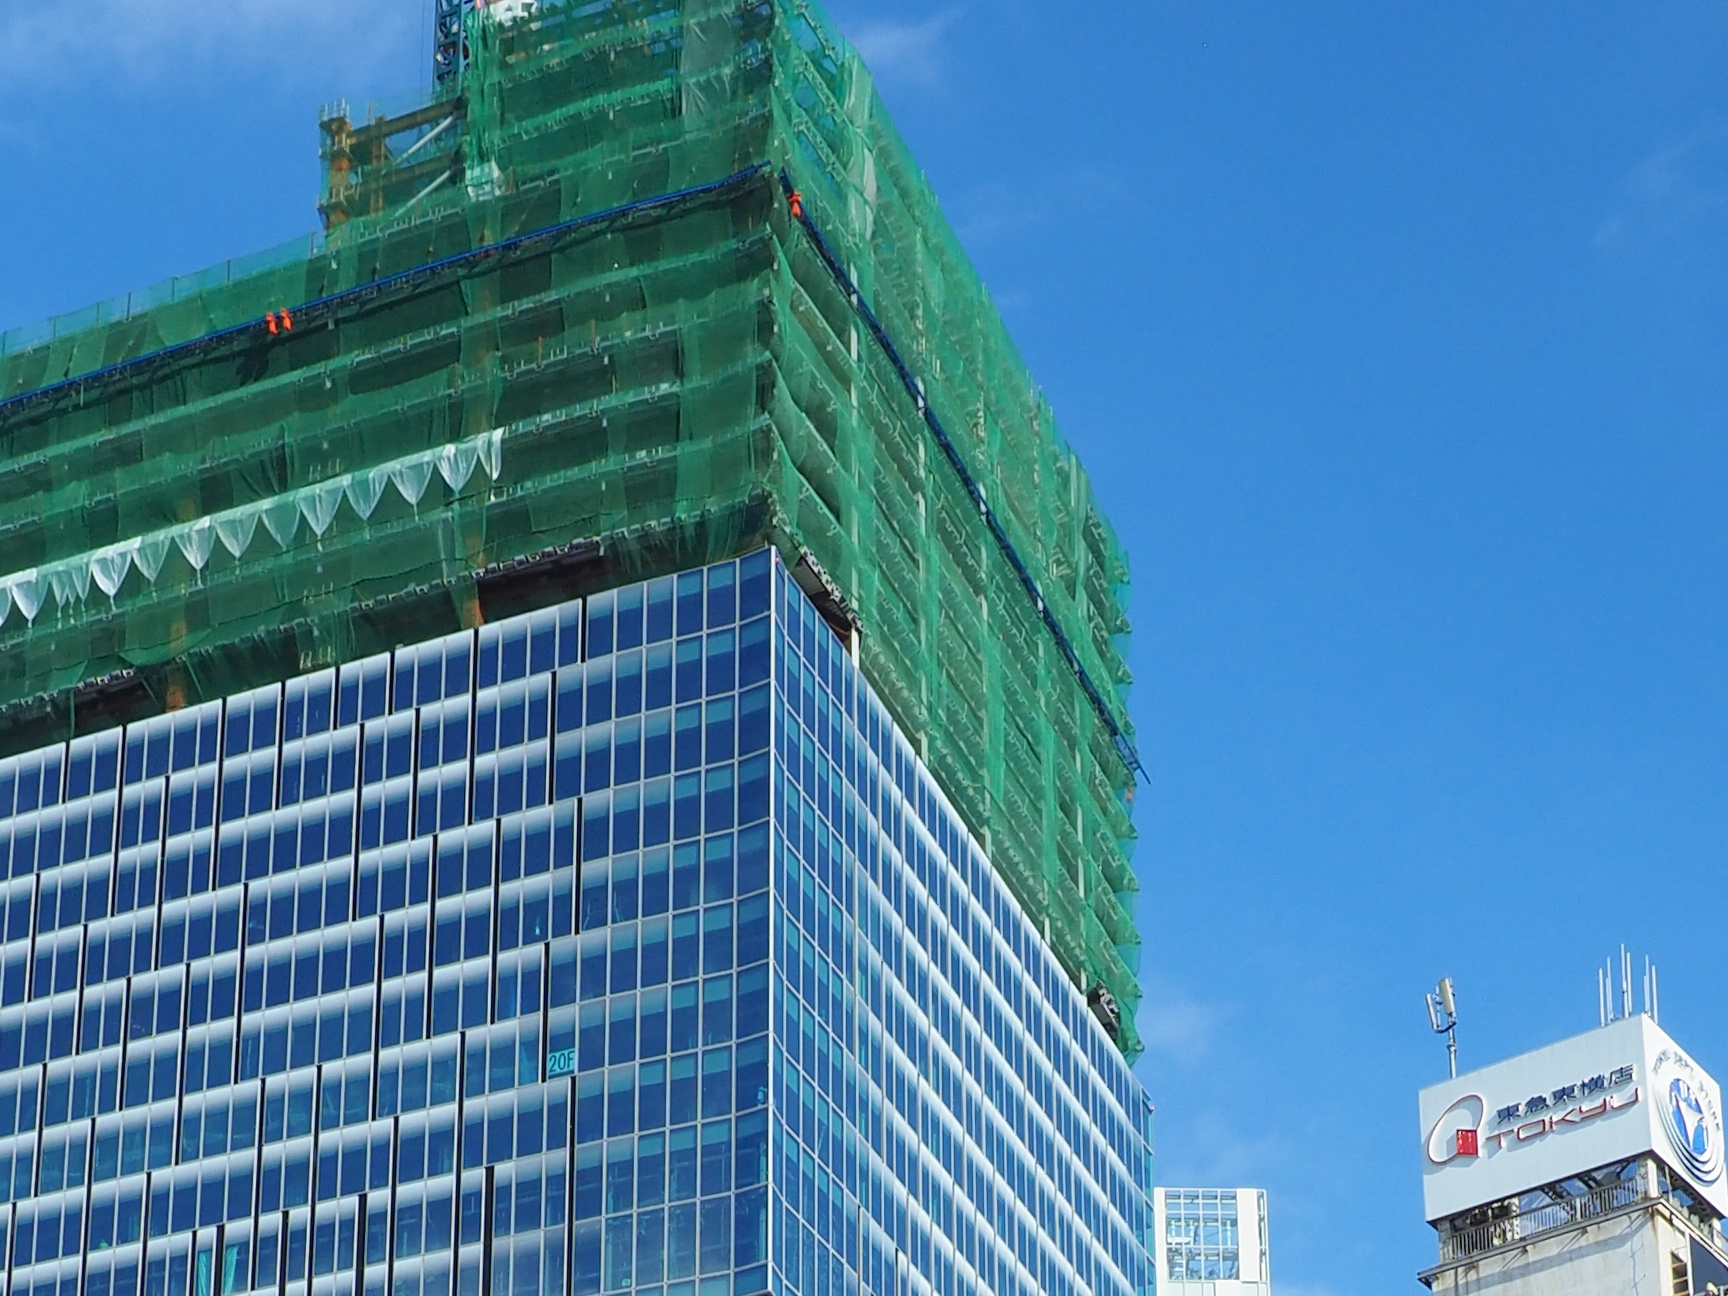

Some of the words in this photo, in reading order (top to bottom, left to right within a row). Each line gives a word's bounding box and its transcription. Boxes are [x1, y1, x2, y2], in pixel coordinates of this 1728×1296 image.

[1486, 1087, 1640, 1149] TOKYU
[1496, 1064, 1634, 1124] 東急東横店
